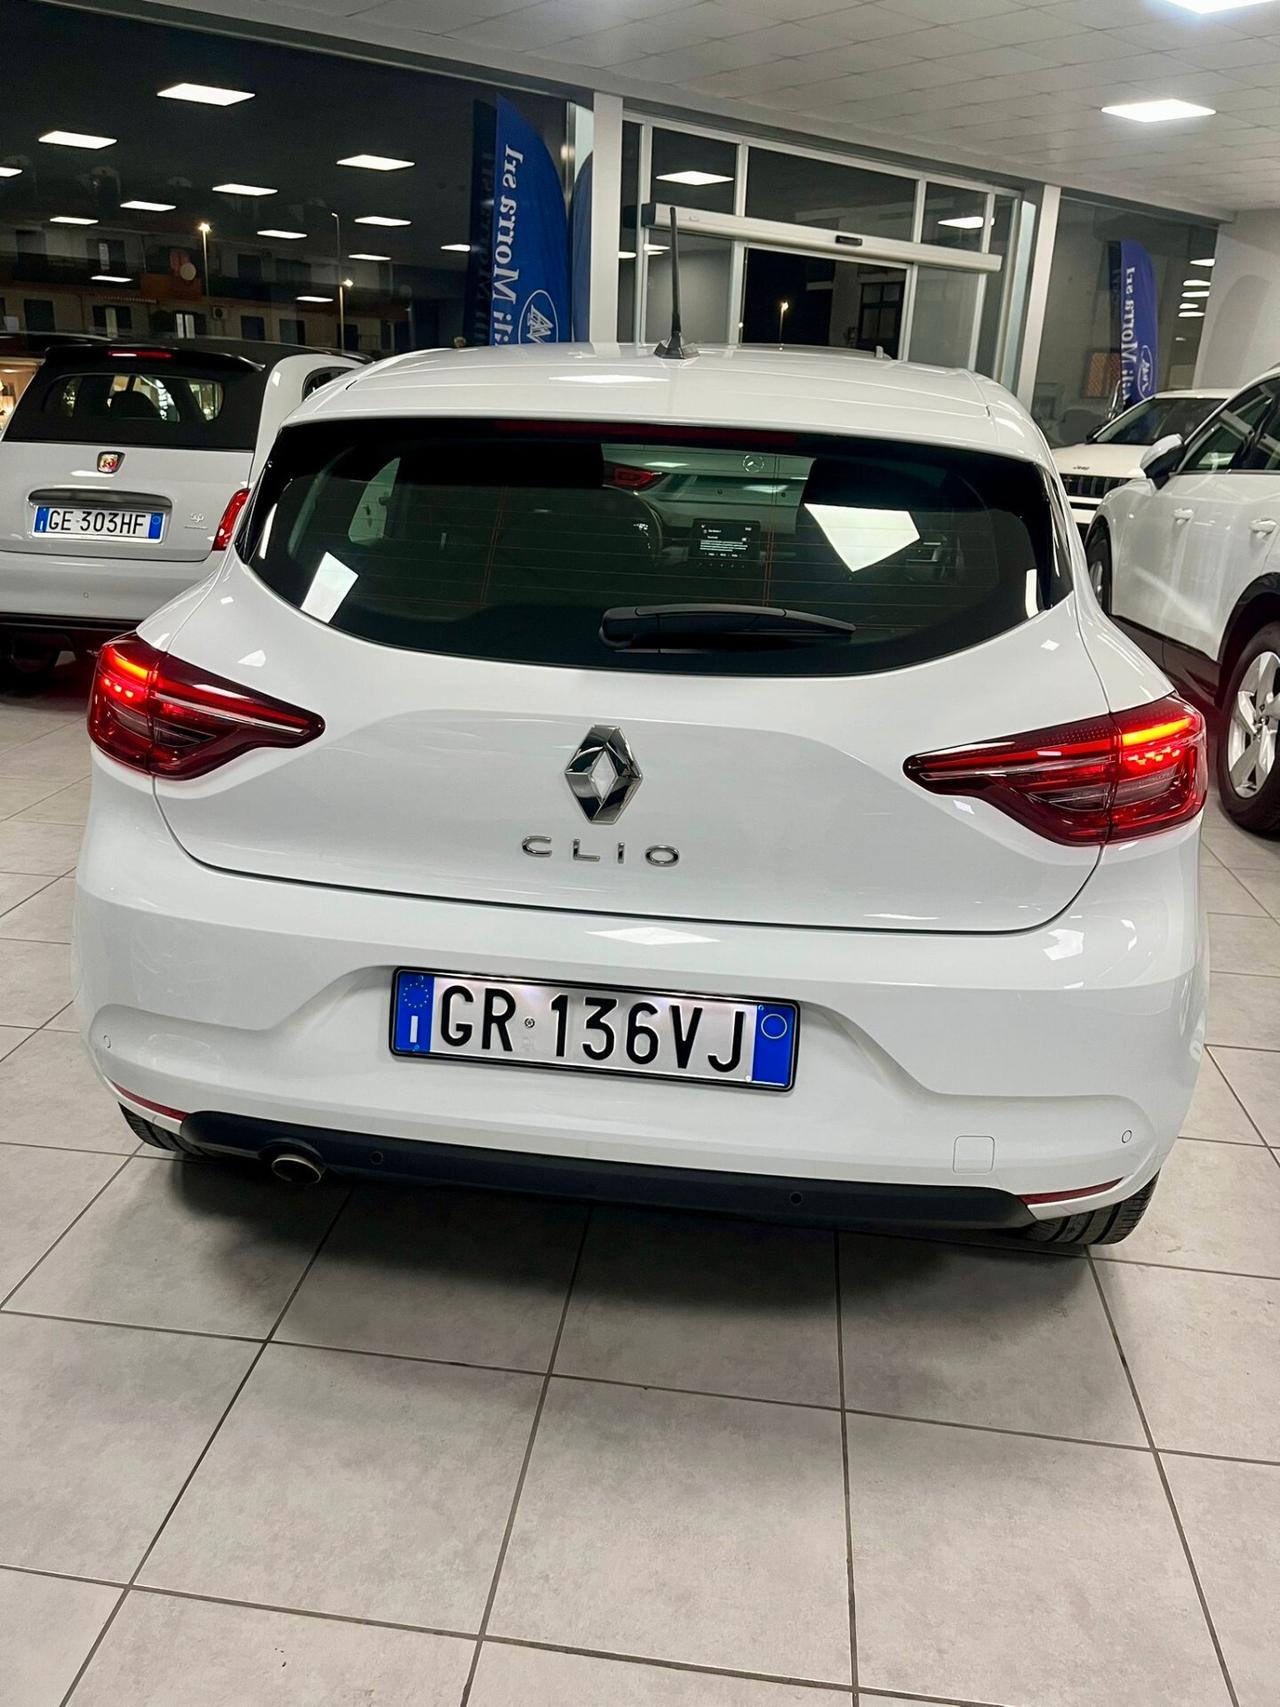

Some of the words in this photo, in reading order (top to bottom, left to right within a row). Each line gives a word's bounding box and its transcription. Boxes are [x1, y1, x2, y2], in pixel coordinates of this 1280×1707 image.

[48, 510, 73, 531] GE
[80, 511, 146, 534] 303HF
[521, 835, 680, 867] CLIO
[441, 985, 516, 1052] GR
[551, 994, 745, 1073] 136VJ
